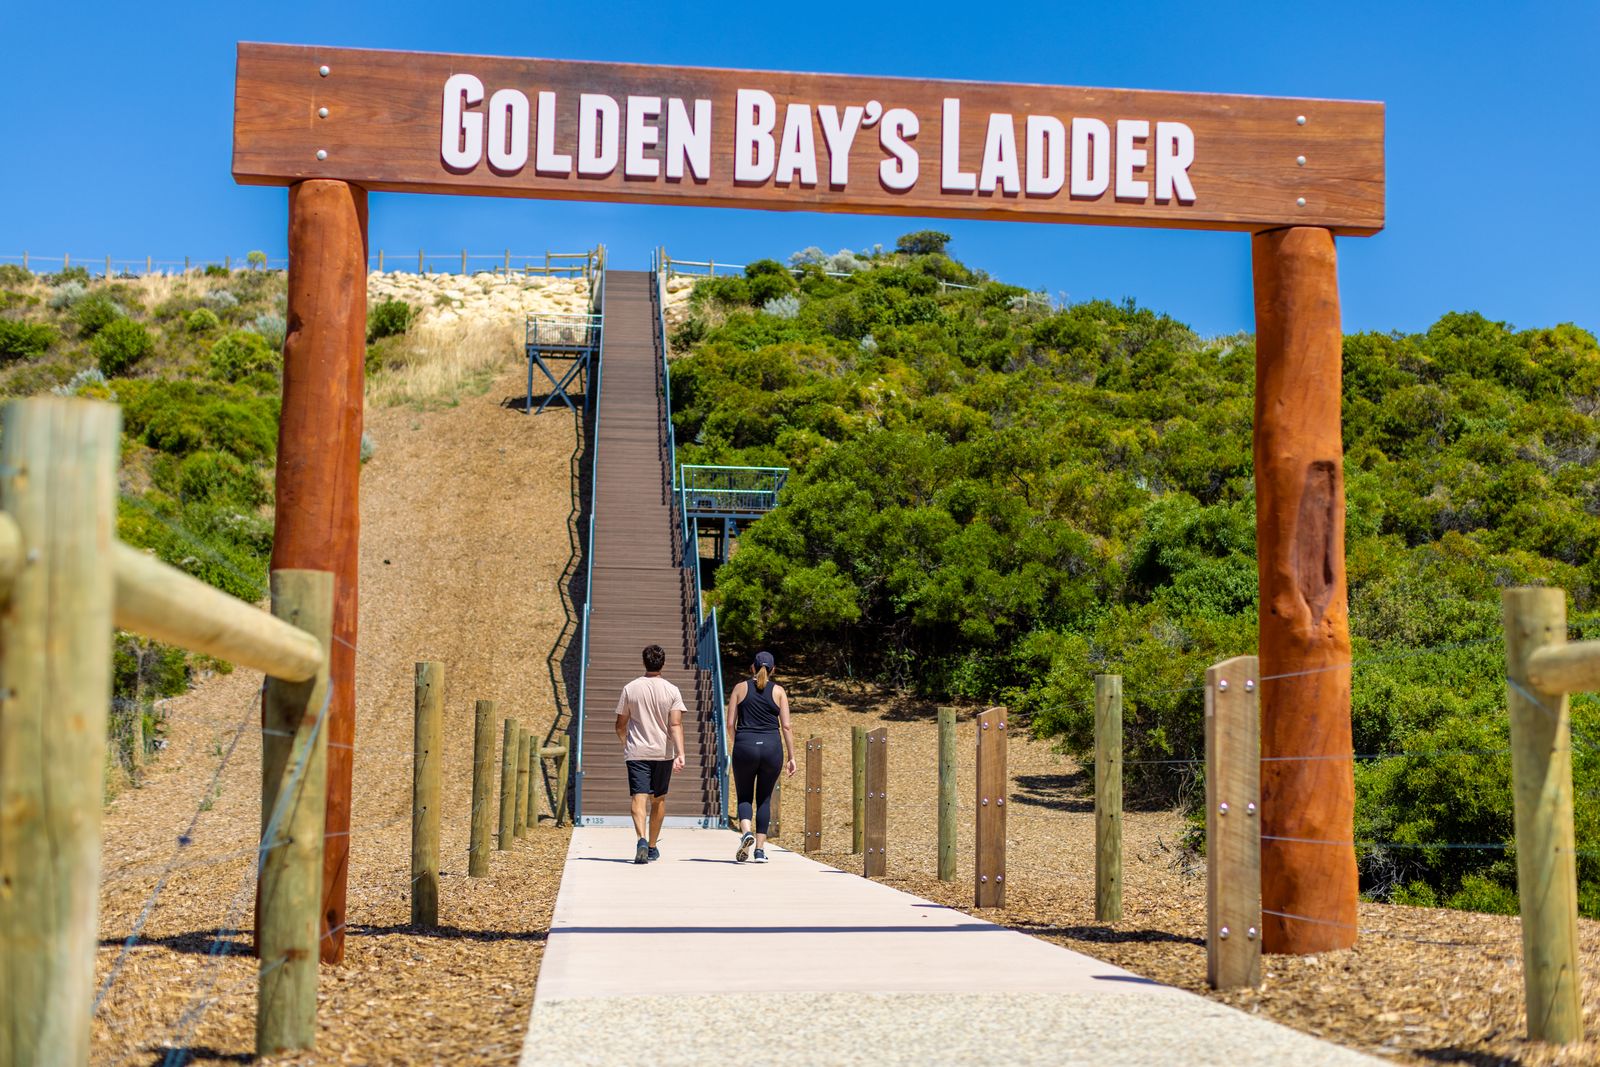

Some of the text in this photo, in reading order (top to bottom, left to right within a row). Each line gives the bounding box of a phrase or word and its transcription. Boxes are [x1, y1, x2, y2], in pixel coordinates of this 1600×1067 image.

[441, 73, 1197, 201] GOLDEN BAY’S LADDER
